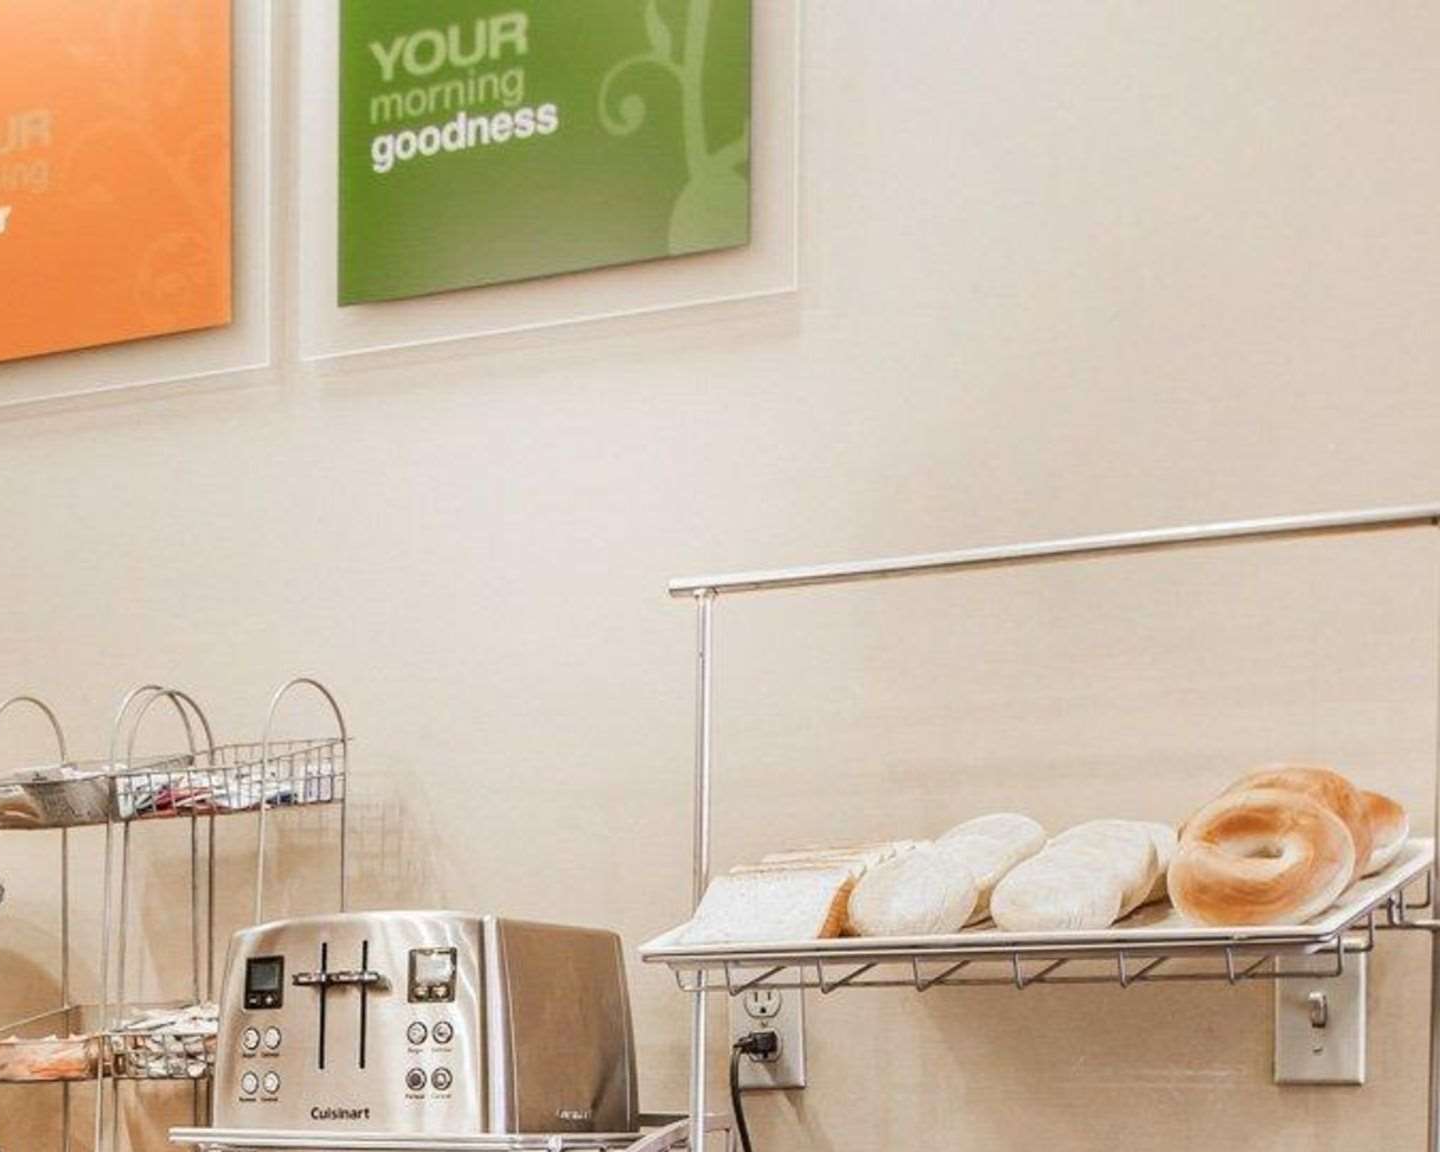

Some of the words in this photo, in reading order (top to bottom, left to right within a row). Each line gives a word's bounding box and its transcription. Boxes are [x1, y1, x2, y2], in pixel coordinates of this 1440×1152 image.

[368, 12, 529, 81] YOUR
[370, 67, 526, 124] morning
[370, 103, 559, 173] goodness
[310, 1106, 371, 1121] Cuisinart
